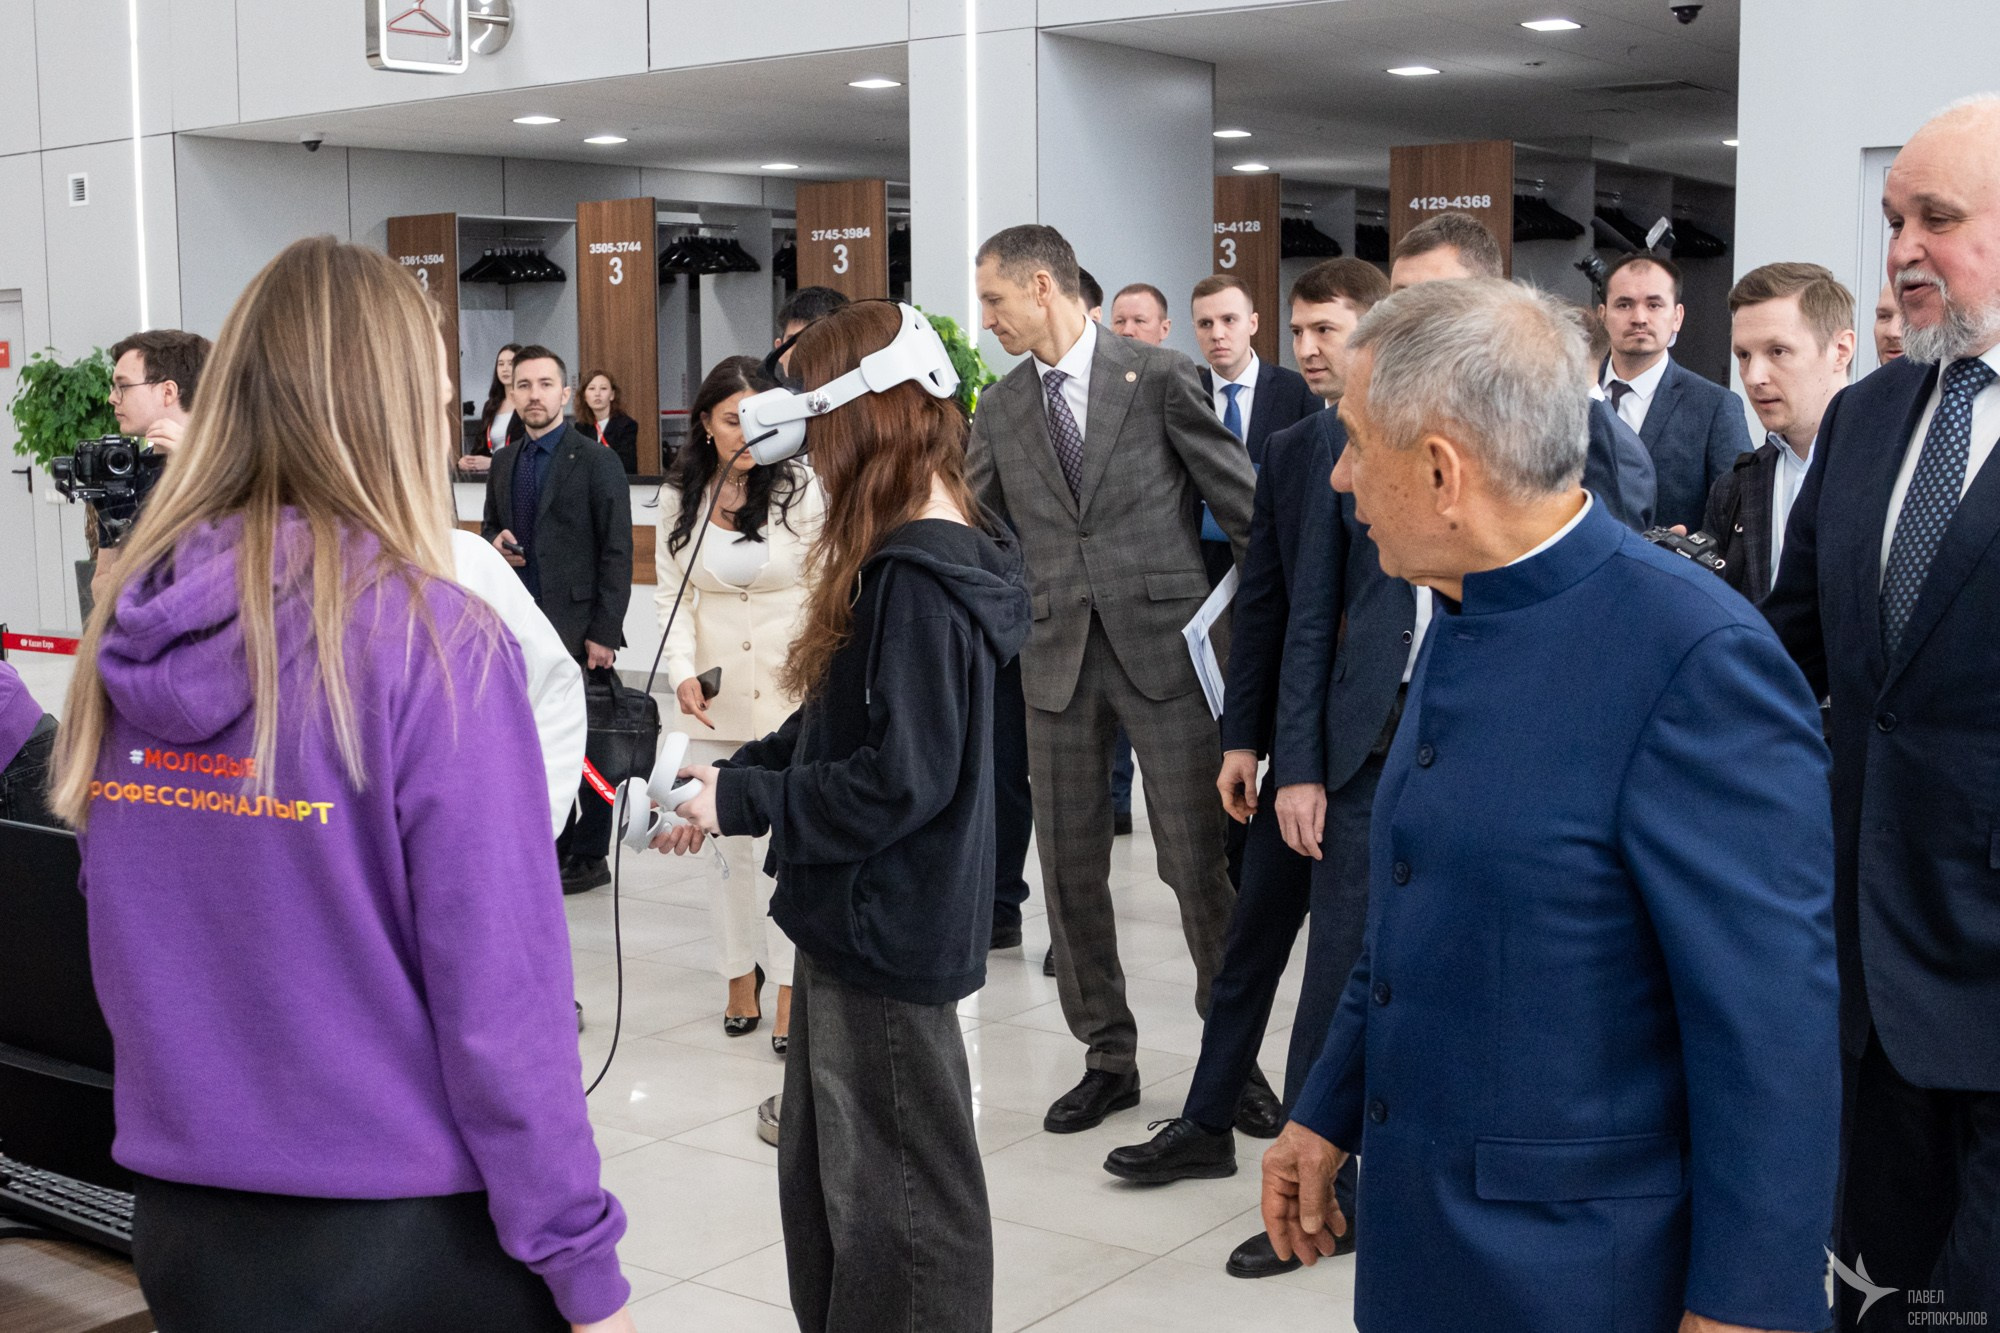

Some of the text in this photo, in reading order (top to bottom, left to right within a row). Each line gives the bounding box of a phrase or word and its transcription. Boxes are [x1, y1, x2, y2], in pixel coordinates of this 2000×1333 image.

[1409, 195, 1491, 210] 4129-4368
[811, 227, 871, 242] 3745-3984
[399, 253, 445, 266] 3361-3504
[589, 241, 642, 255] 3505-3744
[833, 243, 849, 274] 3
[1219, 238, 1237, 269] 3
[417, 268, 429, 292] 3
[609, 256, 623, 285] 3
[129, 748, 258, 779] #МОЛОДЫЕ
[89, 780, 335, 825] РОФЕССИОНАЛЫРТ
